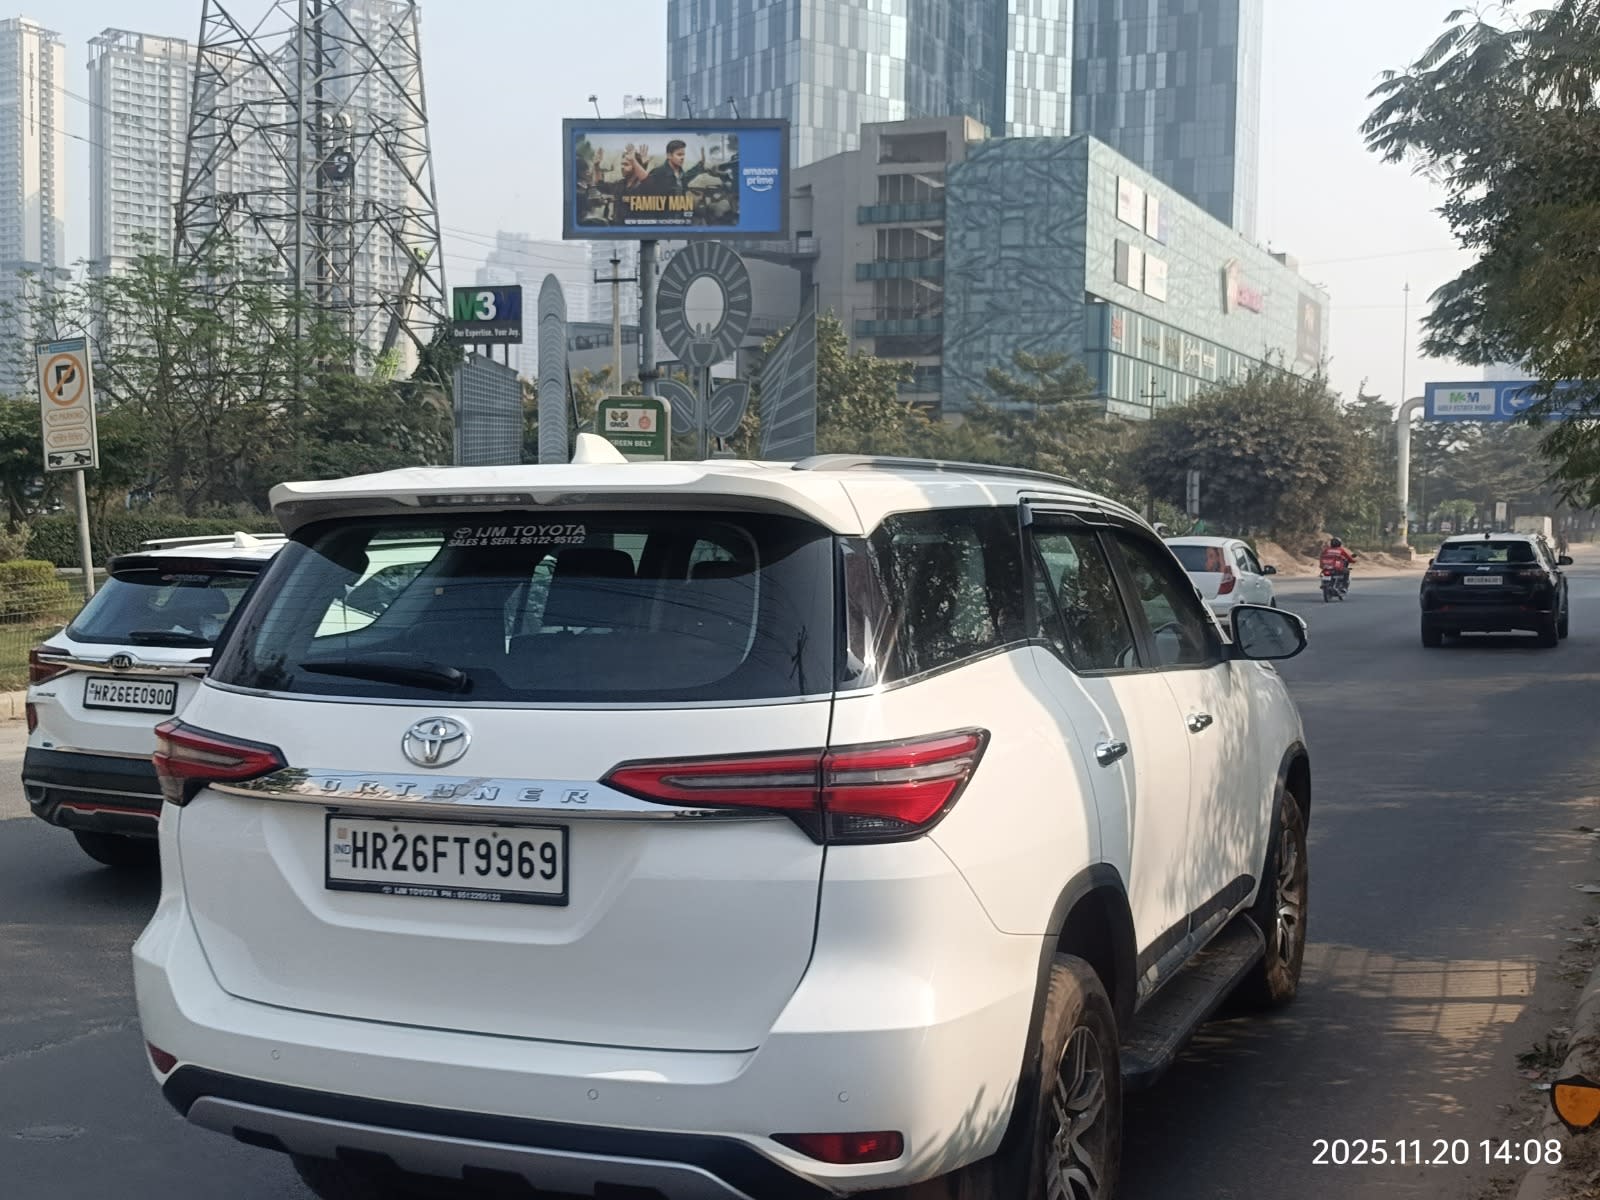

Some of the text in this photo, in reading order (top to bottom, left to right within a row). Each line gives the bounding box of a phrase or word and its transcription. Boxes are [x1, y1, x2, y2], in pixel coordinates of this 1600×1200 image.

[743, 168, 778, 176] amazon
[746, 176, 774, 186] prime
[630, 196, 666, 211] FAMILY
[669, 195, 694, 211] MAN
[454, 291, 520, 321] M3M
[454, 329, 464, 337] Our
[495, 328, 508, 337] Your
[476, 524, 587, 538] IJM TOYOTA
[449, 536, 586, 547] SALES & SERV. 95122-95122
[112, 657, 130, 668] KIA
[94, 683, 173, 706] HR26EE0900
[351, 830, 557, 880] HR26FT9969
[409, 888, 439, 897] TOYOTA
